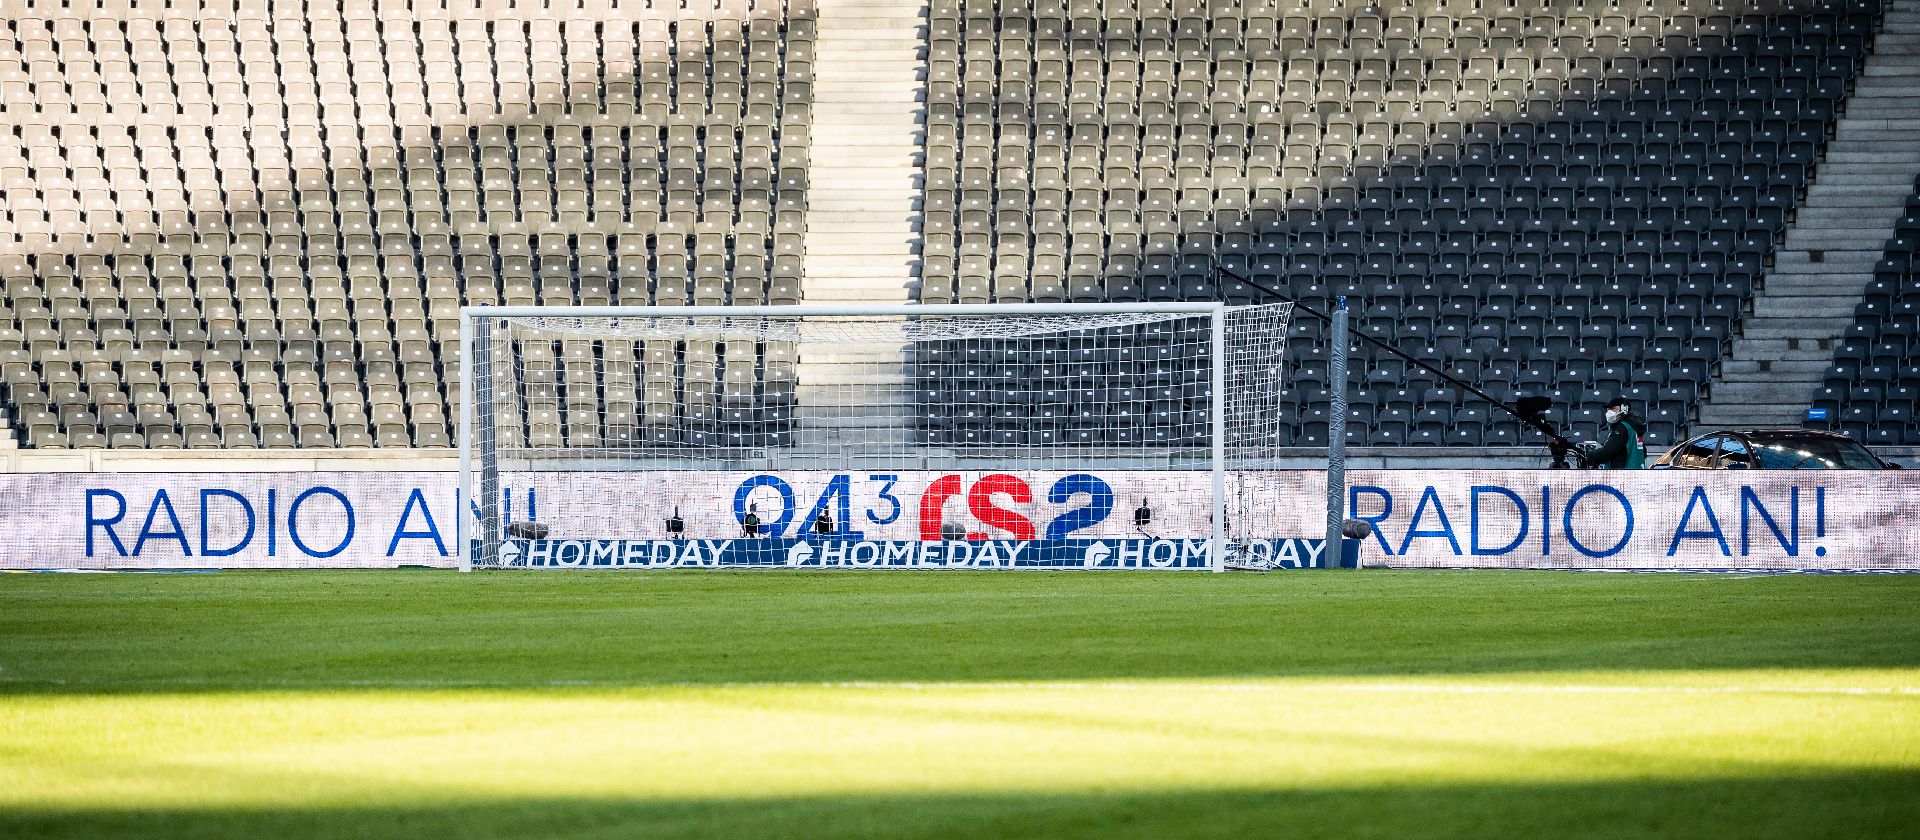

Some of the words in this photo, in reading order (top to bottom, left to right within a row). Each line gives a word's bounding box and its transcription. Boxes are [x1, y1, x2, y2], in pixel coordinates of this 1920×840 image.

[85, 487, 355, 558] RADIO
[1350, 484, 1634, 558] RADIO
[1666, 485, 1827, 557] AN!
[527, 540, 733, 568] HOMEDAY
[820, 540, 1029, 568] HOMEDAY
